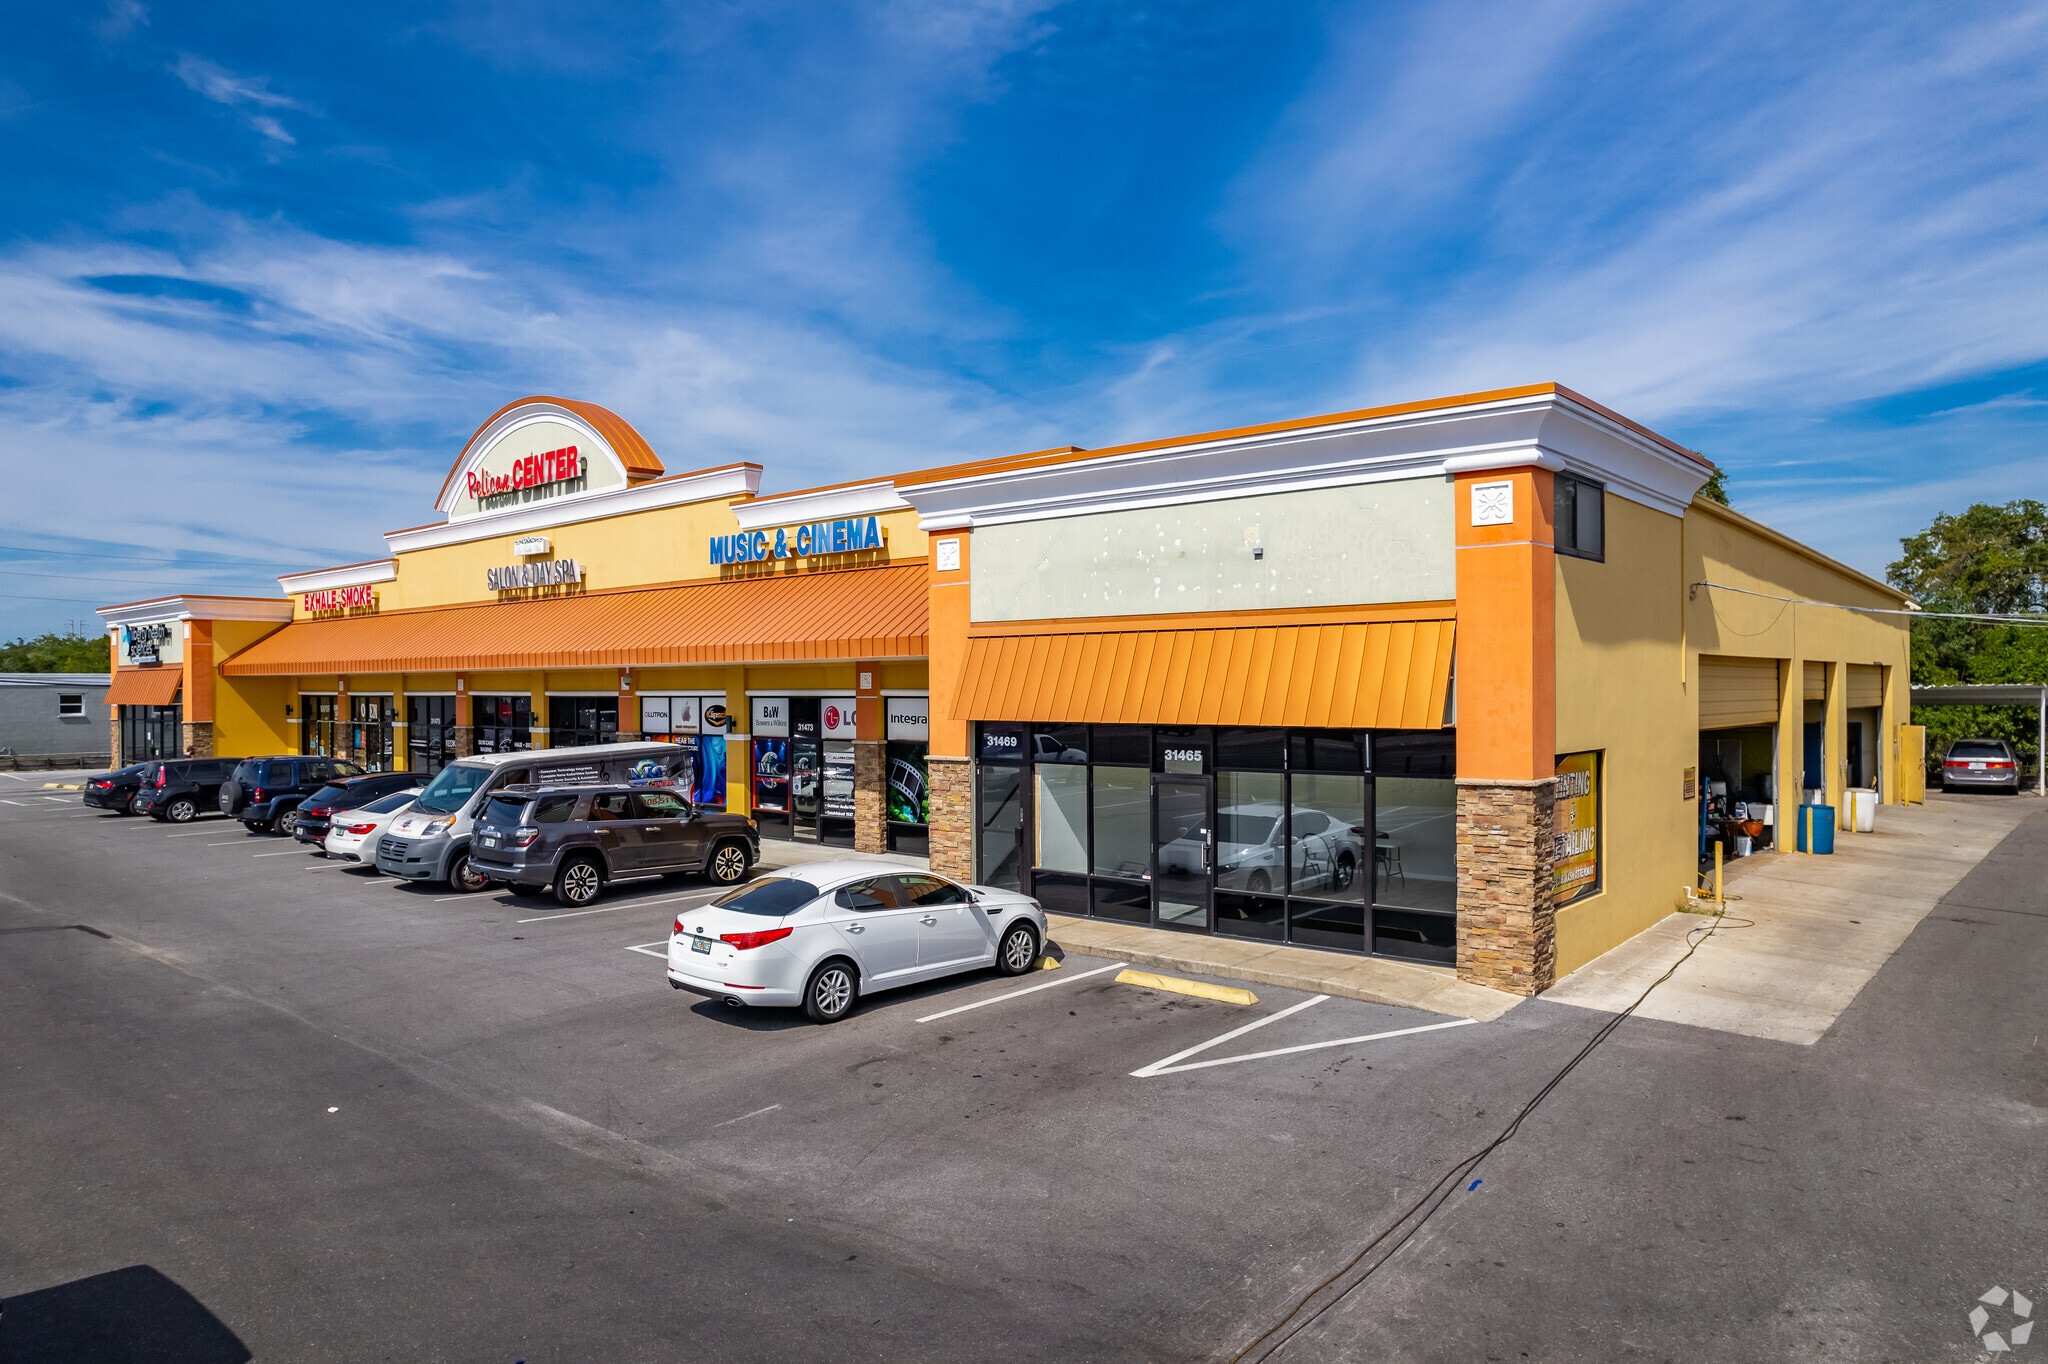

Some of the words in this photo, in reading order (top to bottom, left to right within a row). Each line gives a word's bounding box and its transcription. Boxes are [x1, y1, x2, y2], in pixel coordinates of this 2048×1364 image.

[467, 468, 510, 499] Pelican
[512, 445, 578, 489] CENTER
[709, 530, 767, 565] MUSIC
[773, 528, 788, 559] &
[796, 516, 880, 556] CINEMA
[487, 565, 518, 591] SALON
[522, 564, 529, 587] &
[533, 561, 551, 585] DAY
[555, 559, 576, 584] SPA
[304, 589, 337, 612] EXHALE
[340, 585, 372, 608] SMOKE
[763, 706, 779, 718] B&W
[890, 713, 927, 725] Integra
[797, 723, 814, 732] 31473
[987, 736, 1017, 747] 31469
[1164, 749, 1202, 761] 31465
[1554, 826, 1595, 862] ETAILING
